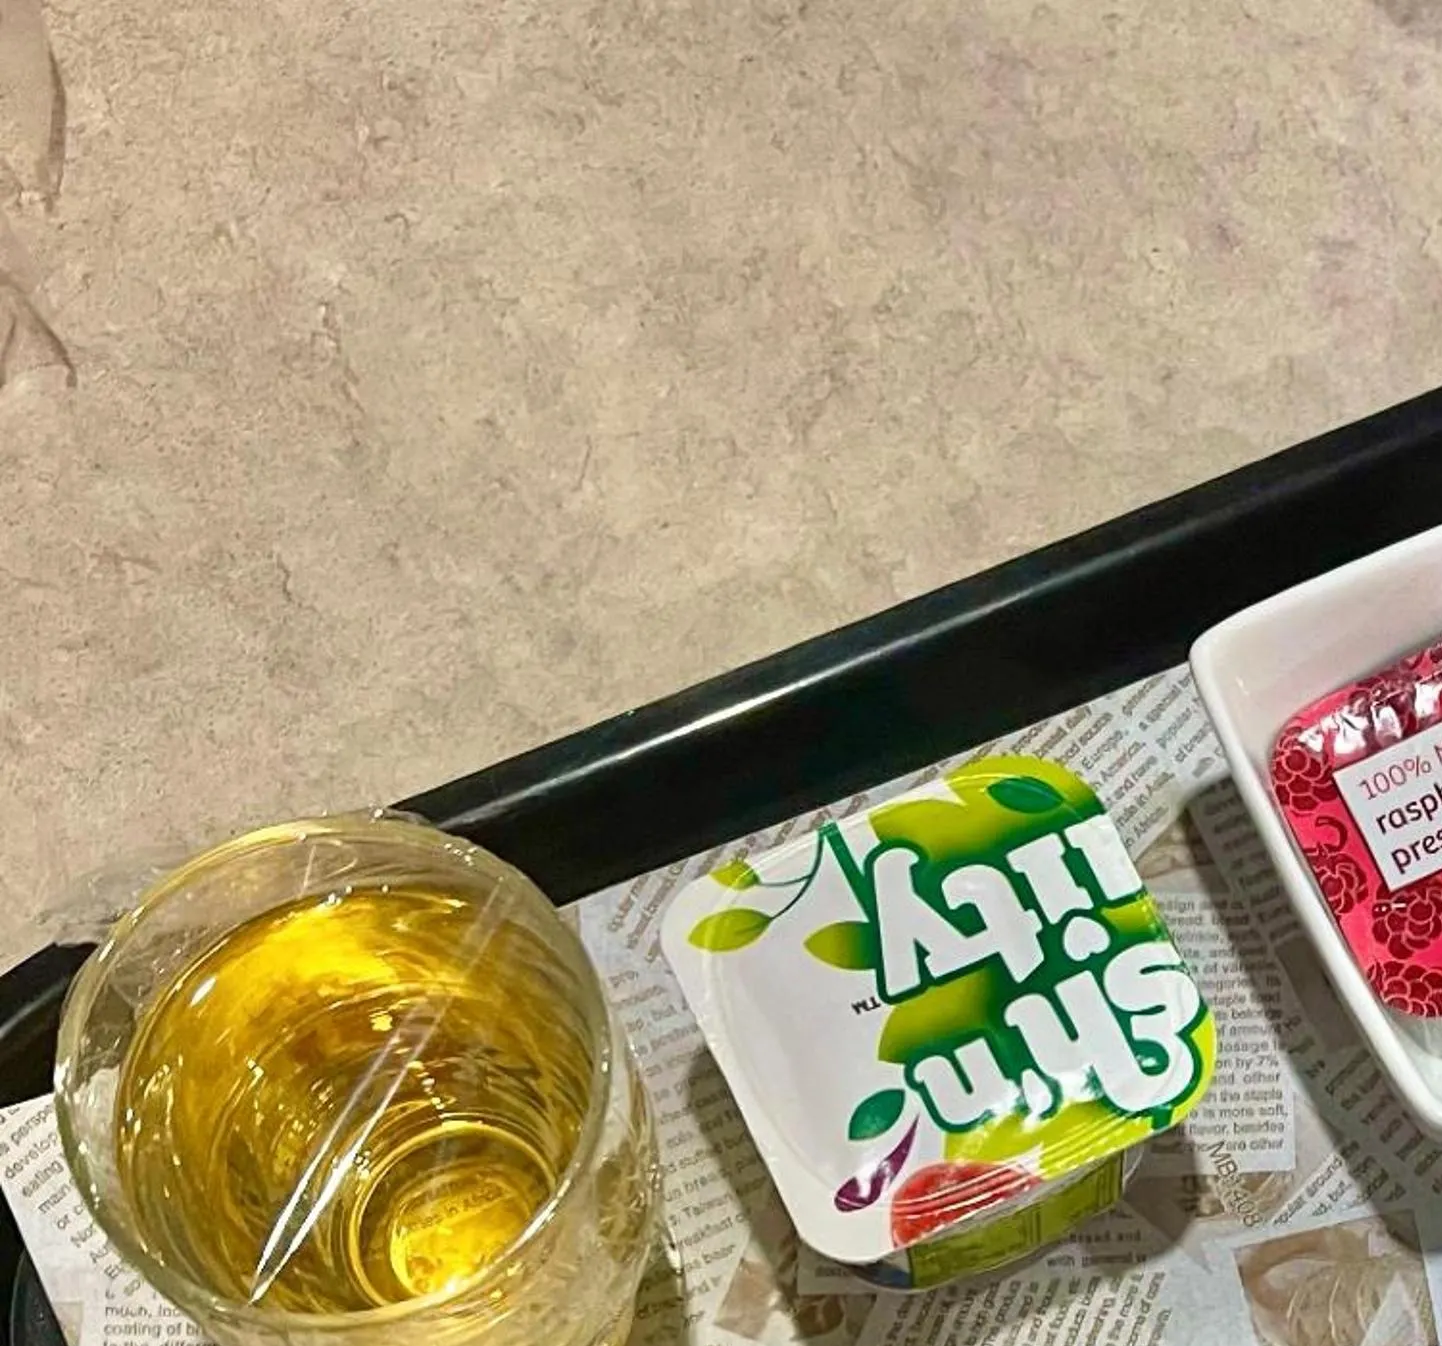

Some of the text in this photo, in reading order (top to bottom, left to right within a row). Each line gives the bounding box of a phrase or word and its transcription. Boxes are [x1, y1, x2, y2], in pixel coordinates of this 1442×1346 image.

[1359, 754, 1432, 801] 100%
[853, 996, 881, 1015] TM
[22, 1160, 65, 1198] eating
[166, 1321, 182, 1336] of
